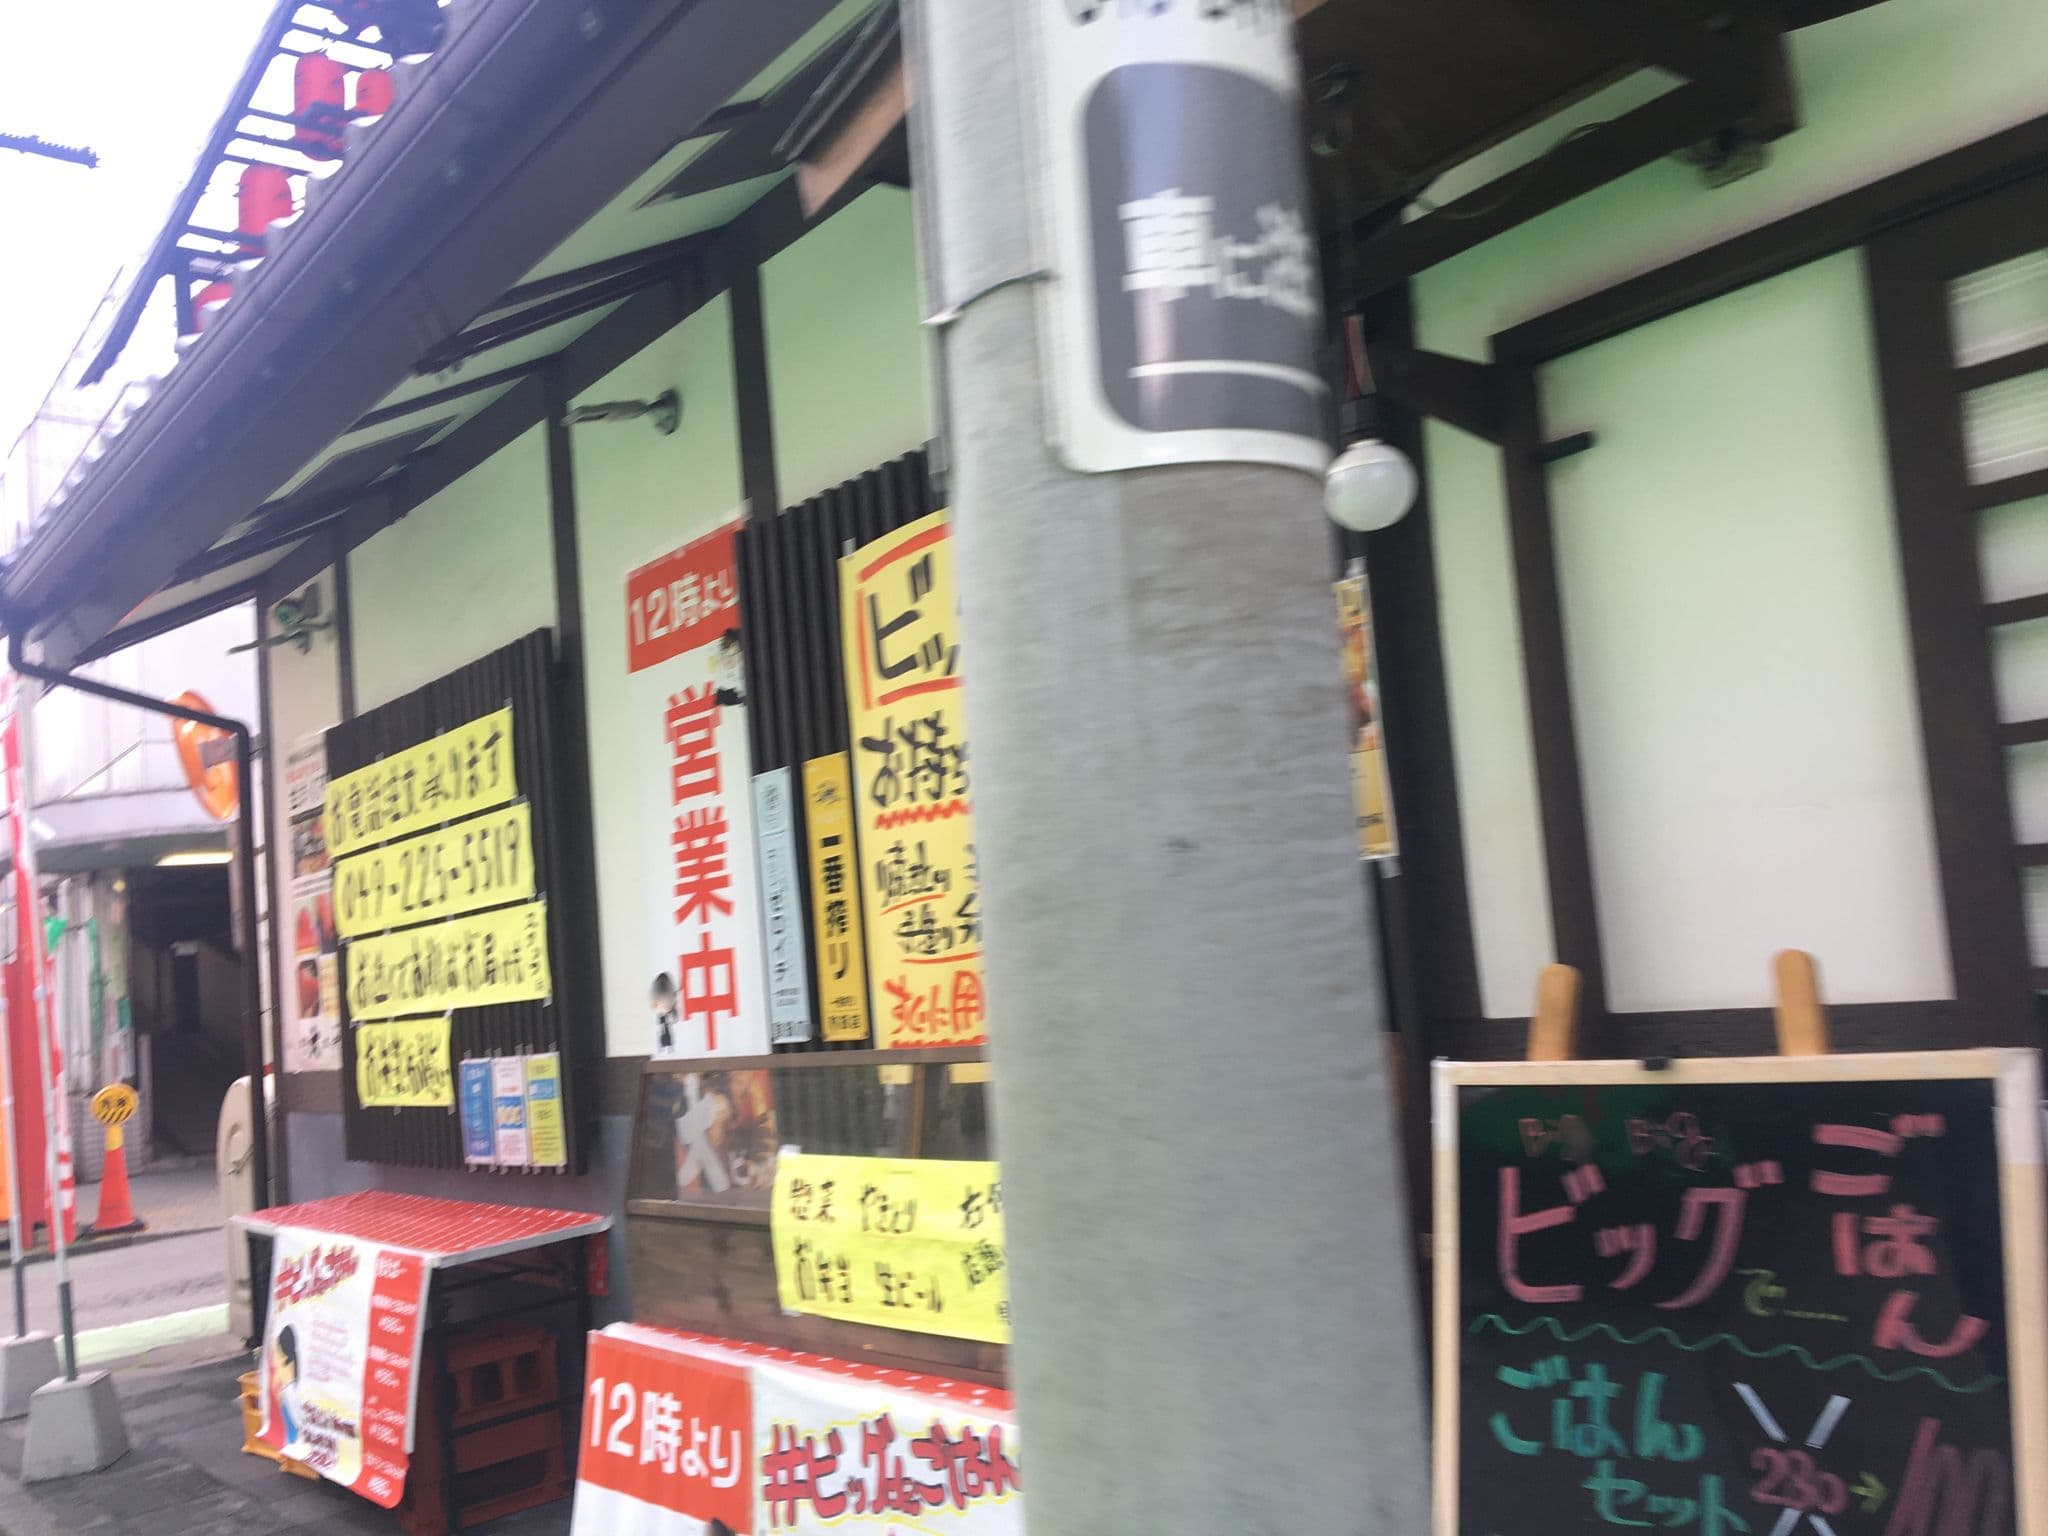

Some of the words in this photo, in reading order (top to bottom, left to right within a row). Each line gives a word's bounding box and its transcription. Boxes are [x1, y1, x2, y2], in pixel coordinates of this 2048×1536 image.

[627, 566, 738, 649] 12時より
[662, 680, 740, 1052] 営業中
[1498, 1160, 1784, 1309] ビッグ
[1811, 1113, 1991, 1358] ごはん
[587, 1377, 742, 1489] 12時より
[1490, 1356, 1706, 1460] ごはん
[1583, 1459, 1750, 1536] セット
